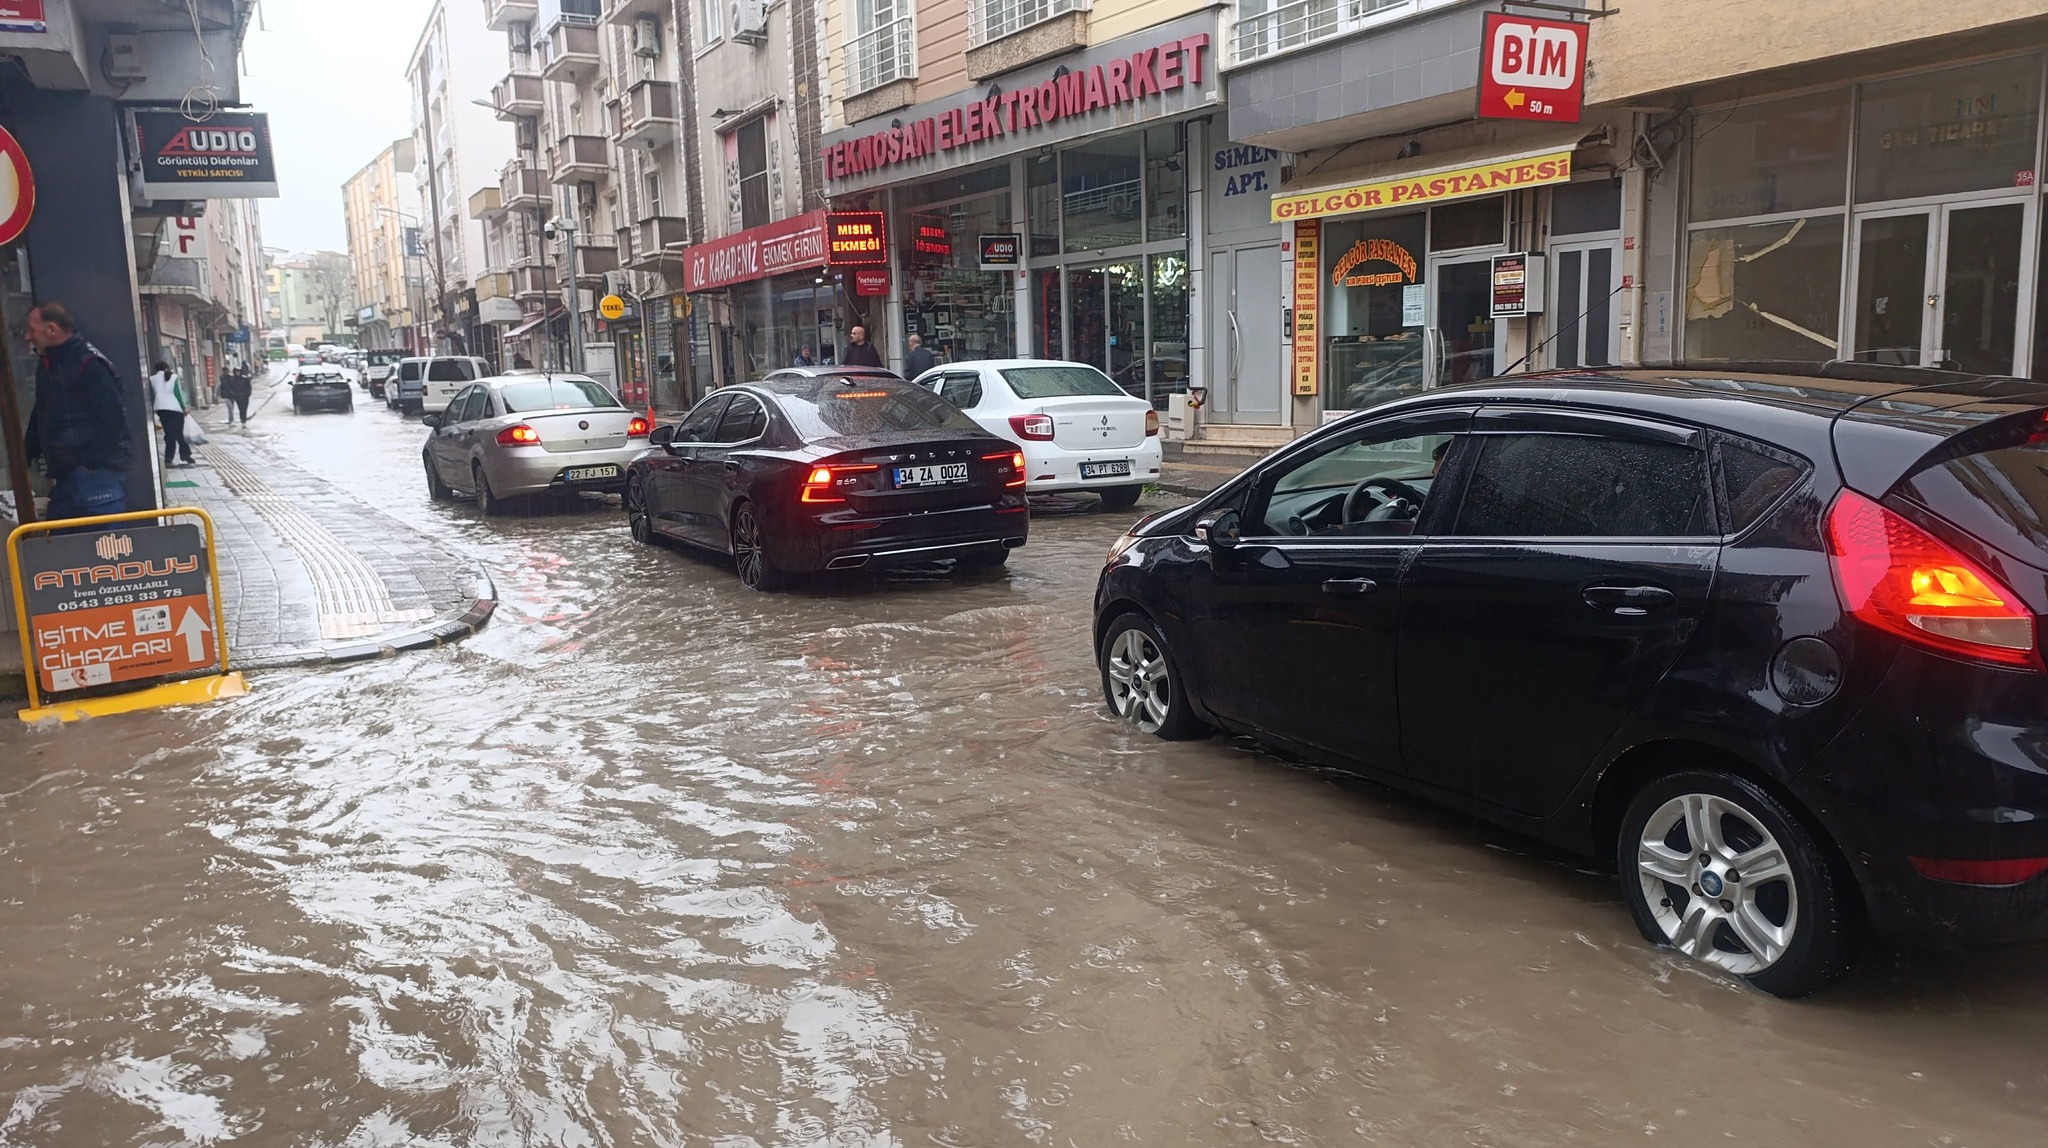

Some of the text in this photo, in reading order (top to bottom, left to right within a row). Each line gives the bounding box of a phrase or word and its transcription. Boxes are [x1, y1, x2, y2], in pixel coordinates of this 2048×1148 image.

[1501, 35, 1567, 77] BIM
[821, 32, 1209, 181] TEKNOSAN ELEKTROMARKET
[1530, 100, 1553, 115] 50 m
[158, 128, 257, 155] AUDIO
[157, 156, 259, 166] Görüntülü Diafonları
[177, 168, 243, 177] YETKİLİ SATICISI
[2017, 172, 2034, 182] 35A
[1224, 170, 1269, 197] APT.
[1276, 188, 1383, 218] GELGÖR
[837, 224, 873, 235] MISIR
[762, 234, 823, 266] EKMEK FIRINI
[832, 238, 880, 252] EKMEĞİ
[985, 242, 1013, 253] AUDIO
[693, 236, 759, 287] ÖZ KARADENİZ
[1333, 240, 1368, 288] GELGÖR
[1346, 276, 1356, 287] KIR
[602, 304, 623, 312] TEKEL
[889, 449, 973, 461] VOLVO
[570, 467, 615, 479] 22 FJ 157
[900, 464, 967, 483] 34 ZA 0022
[1086, 463, 1129, 475] 34 PT 6288
[34, 555, 198, 590] ATADUY
[73, 580, 169, 598] İrem ÖZKAYALARLI
[57, 588, 183, 611] 0543 263 33 78
[38, 620, 127, 649] İŞİTME
[42, 638, 172, 671] CİHAZLARI
